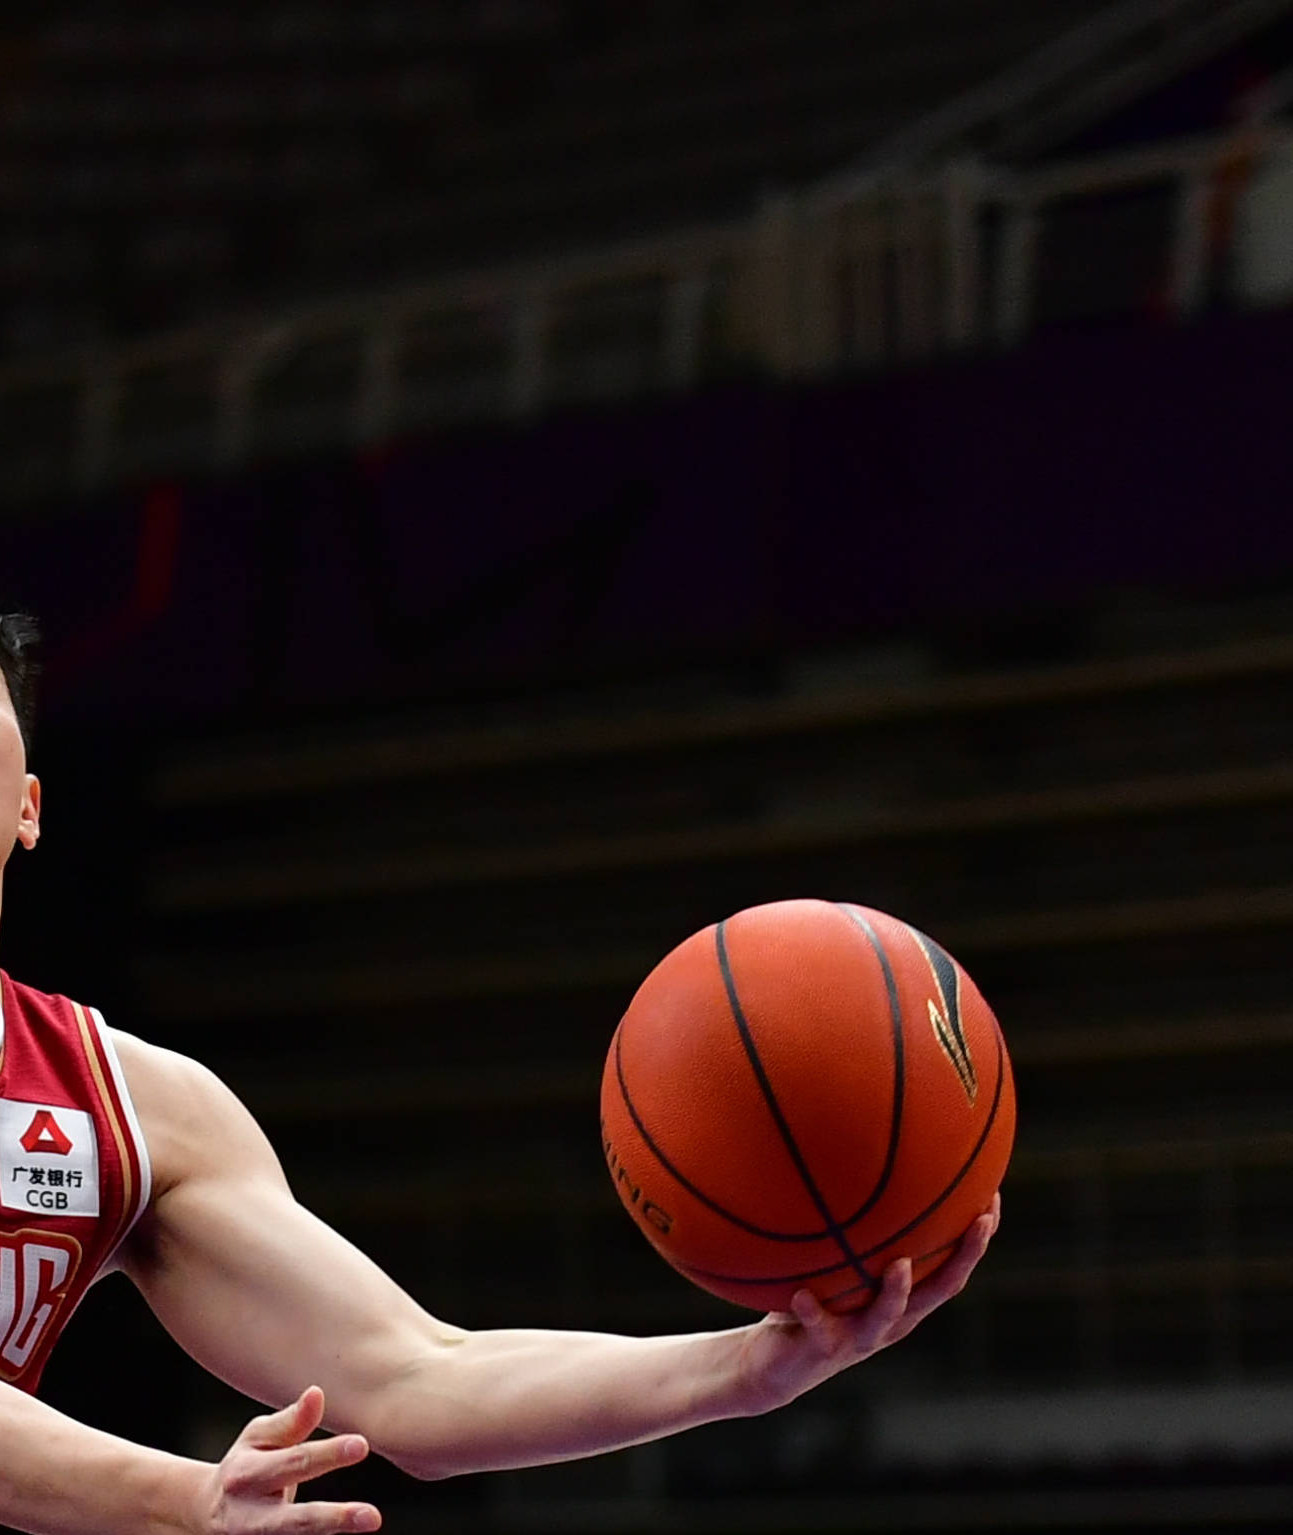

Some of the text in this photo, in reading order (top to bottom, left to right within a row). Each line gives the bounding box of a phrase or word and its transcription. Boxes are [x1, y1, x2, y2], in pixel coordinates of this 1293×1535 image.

[12, 1166, 83, 1188] 广发银行
[26, 1190, 68, 1209] CGB
